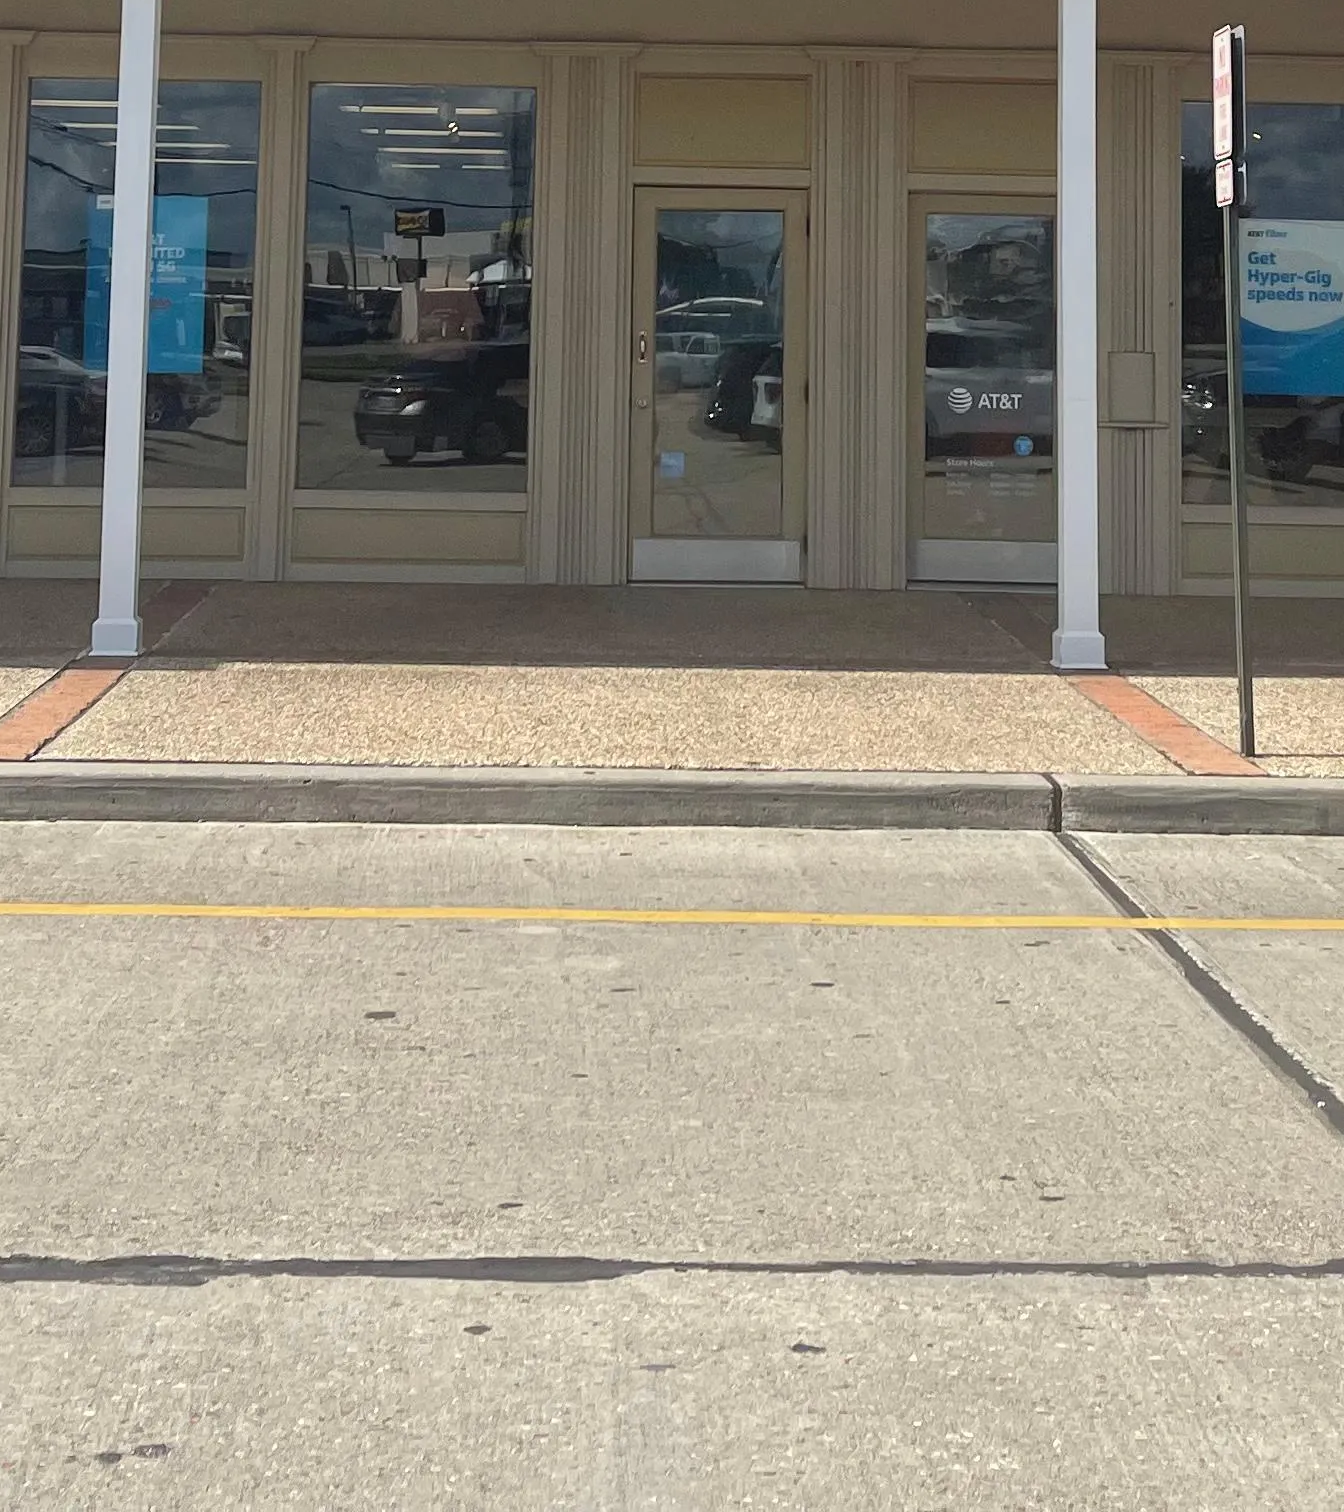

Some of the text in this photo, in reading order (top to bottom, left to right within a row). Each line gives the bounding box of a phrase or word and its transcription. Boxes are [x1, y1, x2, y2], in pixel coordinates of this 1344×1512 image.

[1247, 251, 1277, 265] Get
[1247, 269, 1332, 288] Hyper-Gig
[1247, 287, 1343, 303] speeds now
[978, 393, 1022, 410] AT&T
